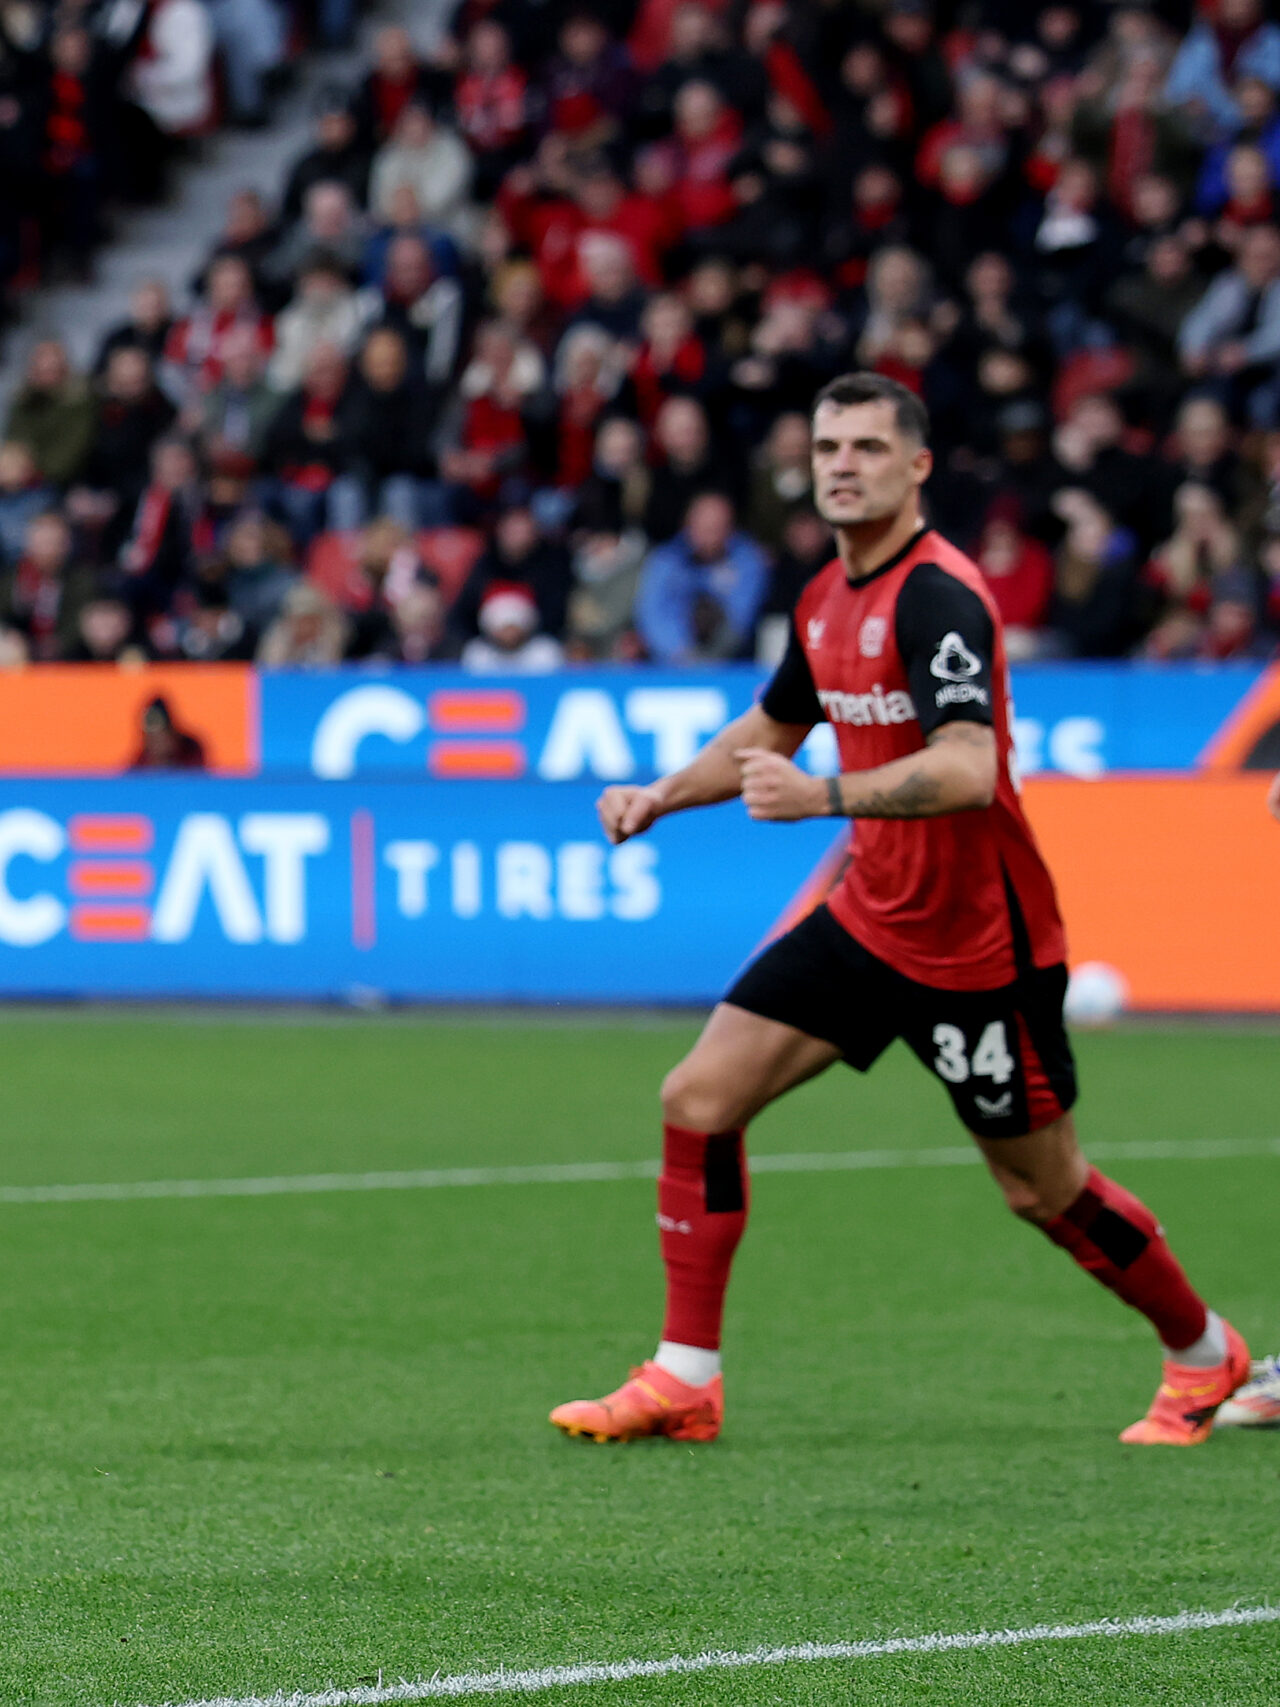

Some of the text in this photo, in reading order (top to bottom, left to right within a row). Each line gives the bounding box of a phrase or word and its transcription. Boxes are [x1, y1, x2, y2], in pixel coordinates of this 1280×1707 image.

[311, 684, 728, 780] CEAT
[383, 840, 662, 921] TIRES
[932, 1020, 1015, 1085] 34
